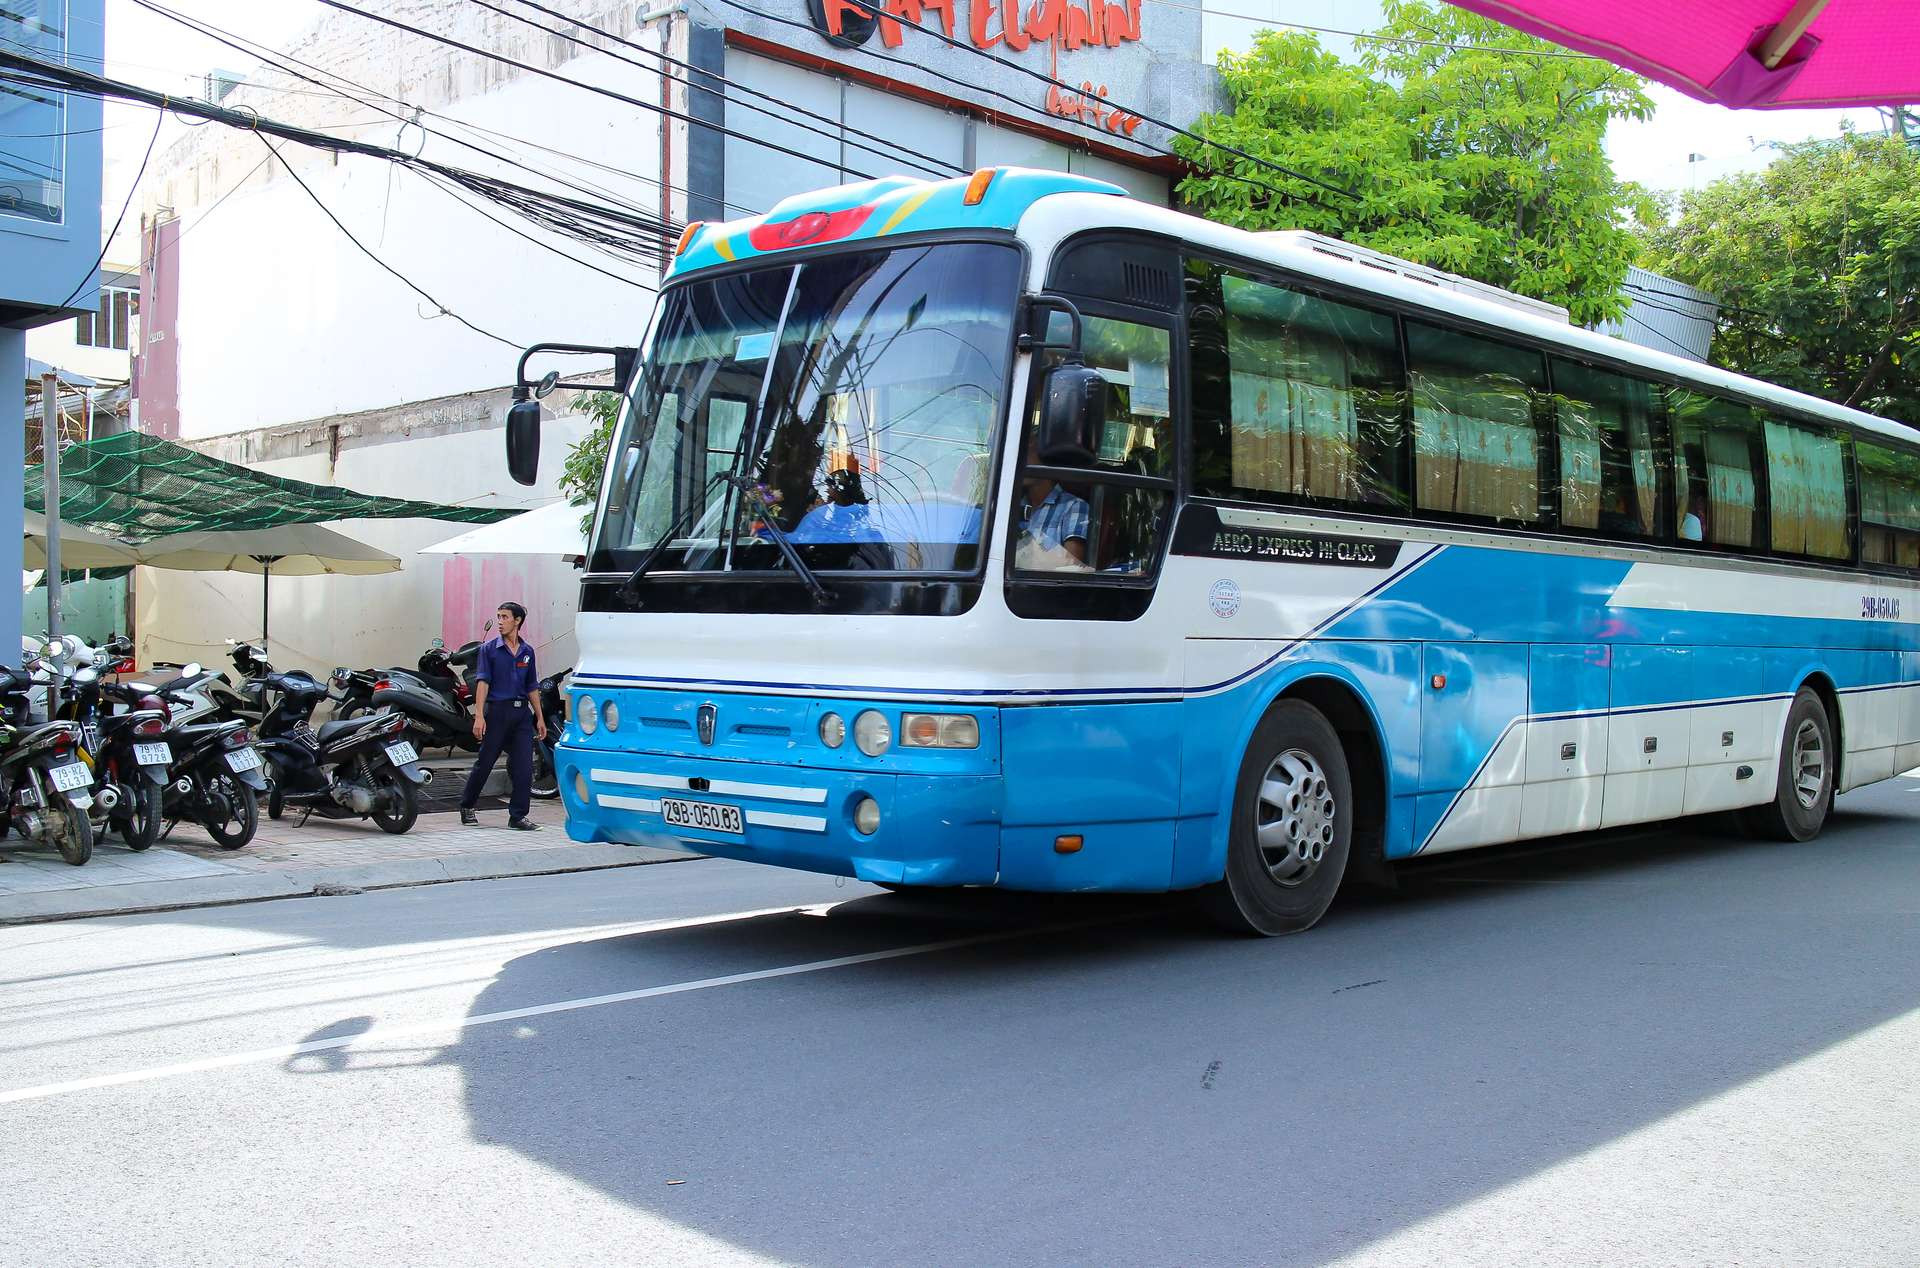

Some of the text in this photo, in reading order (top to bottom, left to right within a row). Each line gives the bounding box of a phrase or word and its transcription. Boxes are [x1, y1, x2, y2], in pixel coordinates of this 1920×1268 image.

[1212, 531, 1376, 562] AERO EXPRESS HI-CLASS
